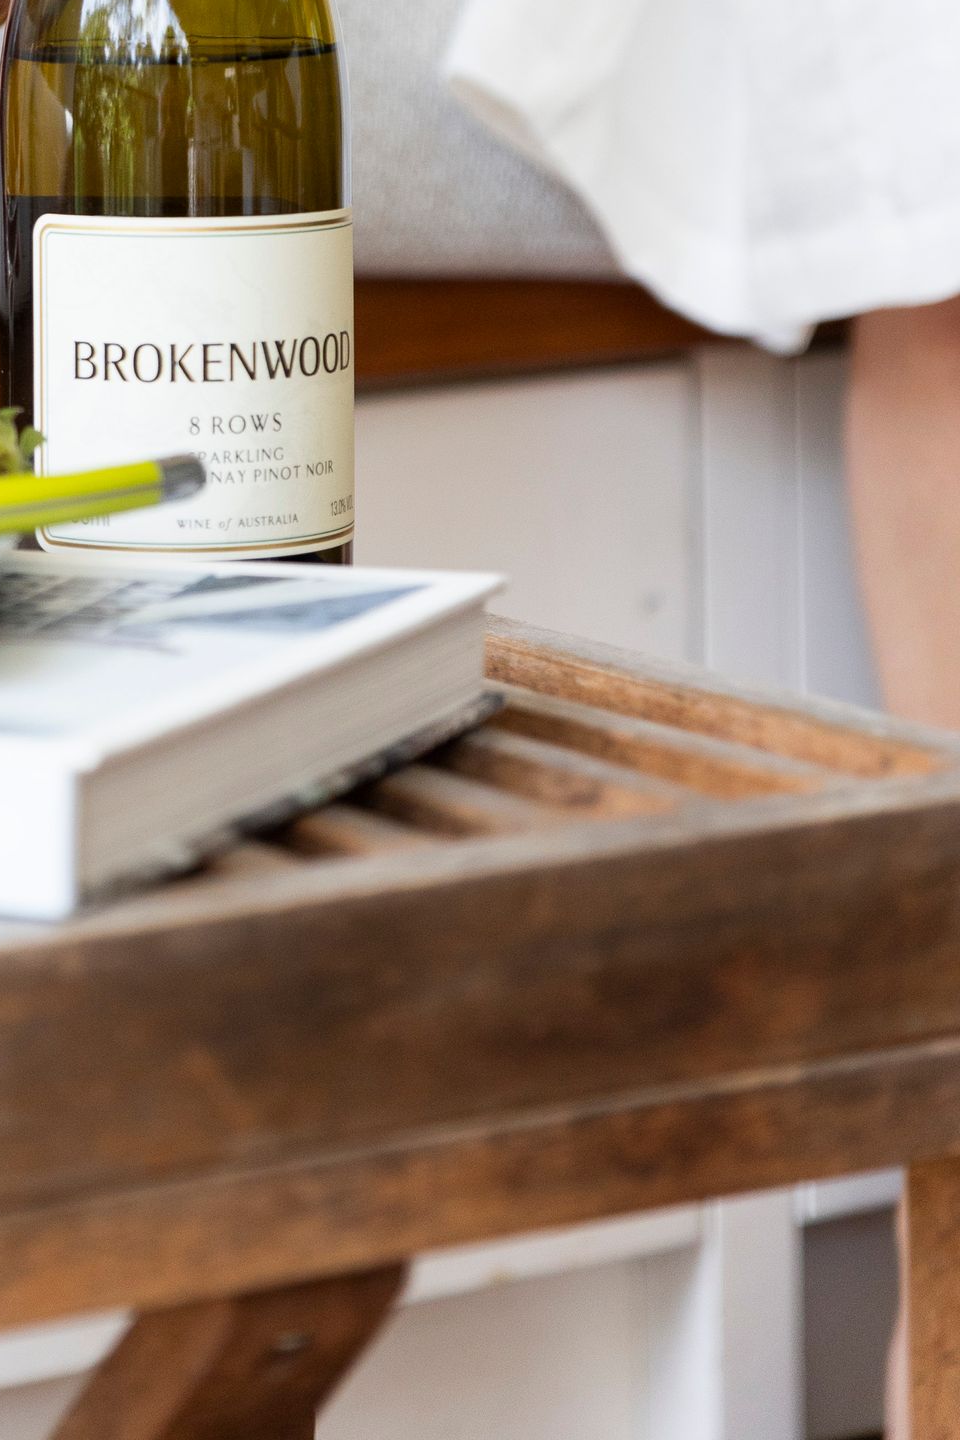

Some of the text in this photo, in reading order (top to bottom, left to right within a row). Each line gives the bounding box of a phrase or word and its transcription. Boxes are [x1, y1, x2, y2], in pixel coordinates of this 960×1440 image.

[73, 330, 351, 383] BROKENWOOD
[189, 412, 282, 436] 8 ROWS
[254, 465, 301, 483] PINOT
[306, 459, 334, 477] NOIR
[176, 512, 300, 532] WINE of AUSTRALIA
